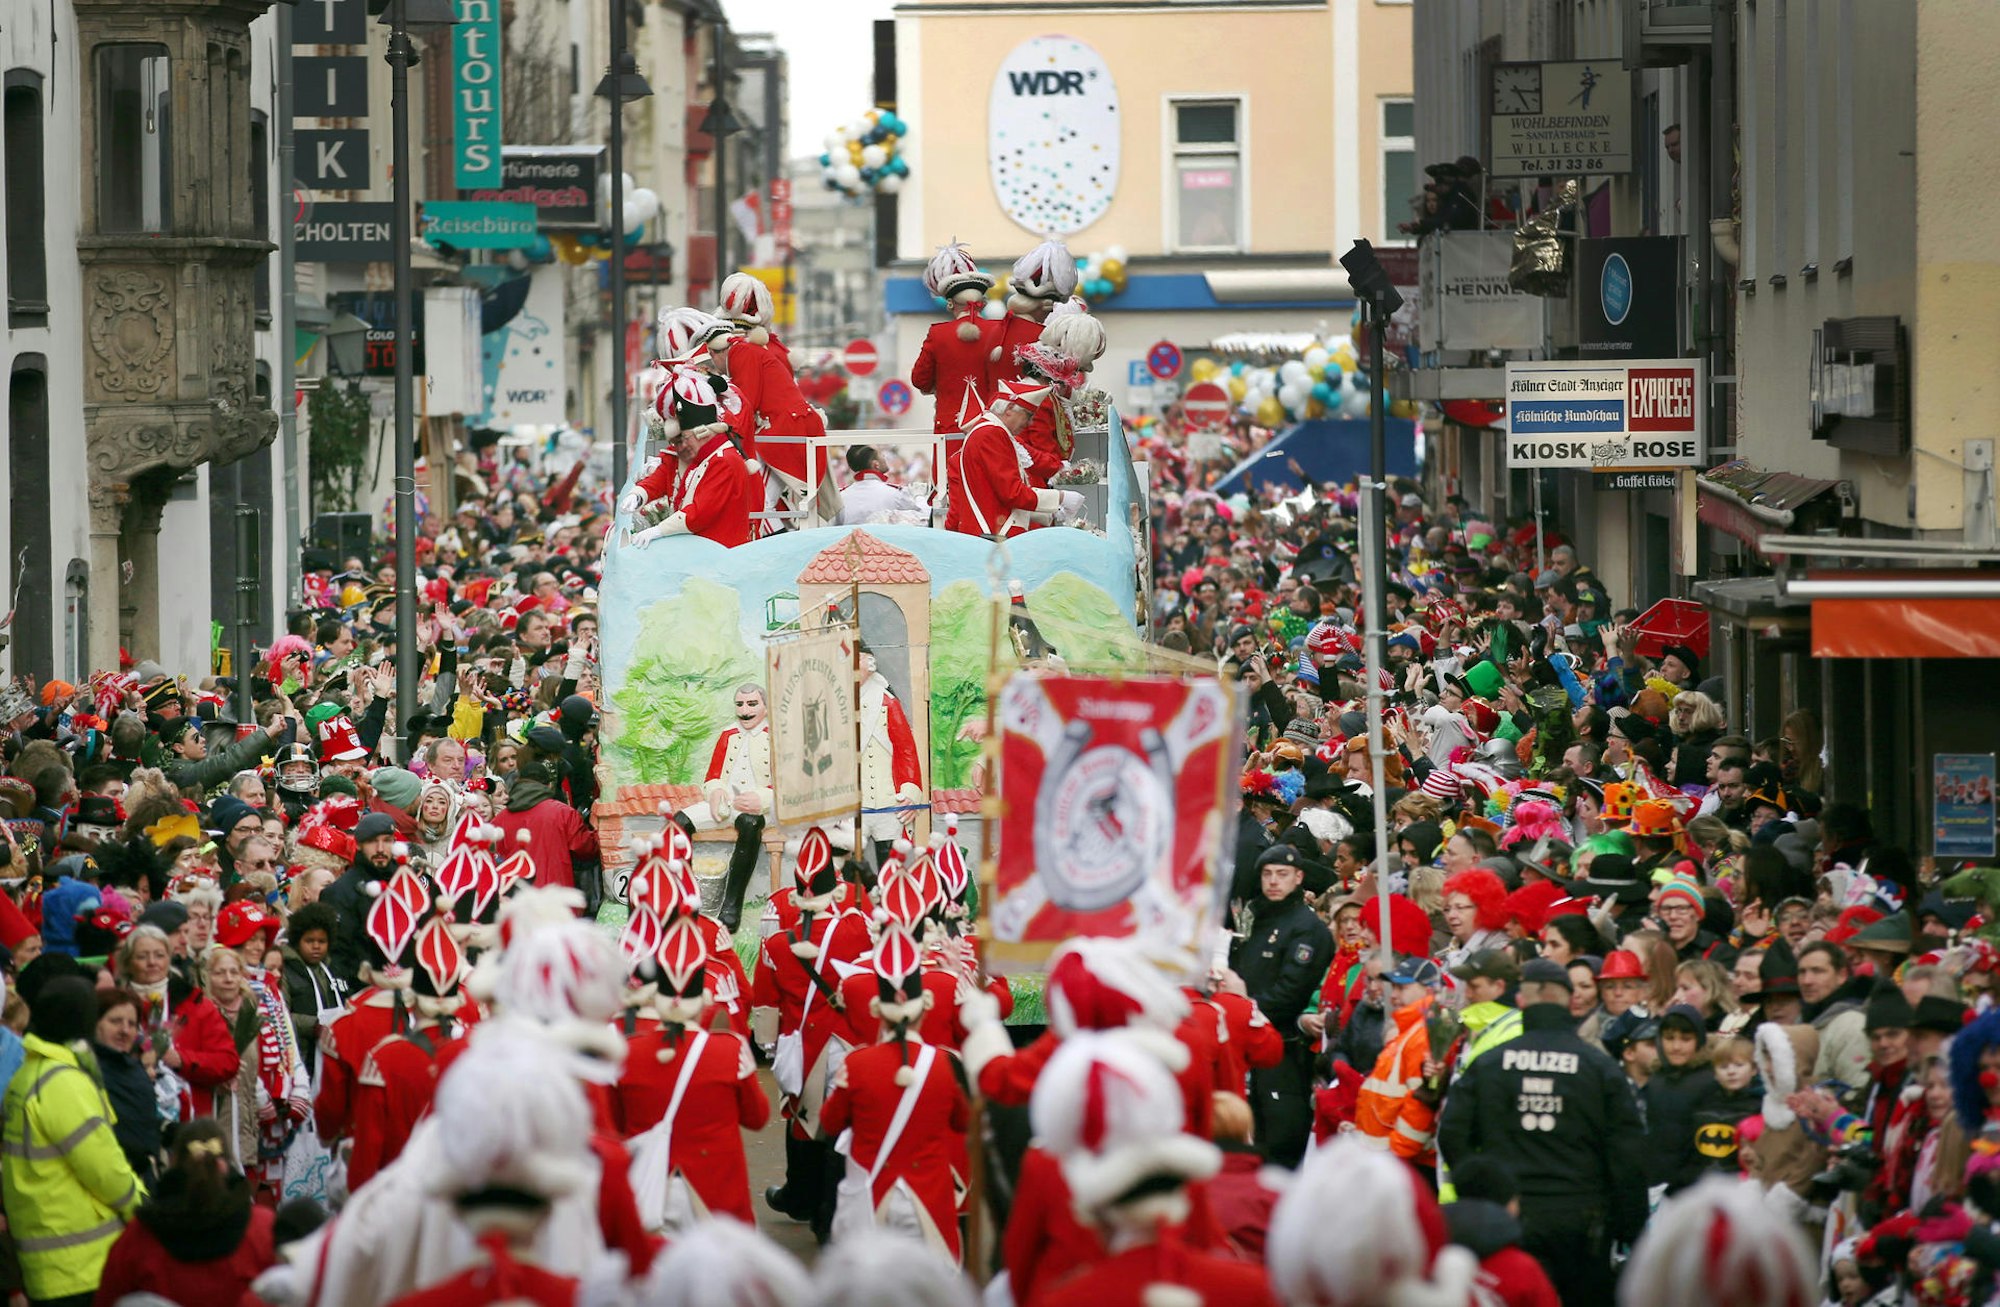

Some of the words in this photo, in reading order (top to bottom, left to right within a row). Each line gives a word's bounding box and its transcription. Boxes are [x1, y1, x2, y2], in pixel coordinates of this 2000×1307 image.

[1008, 70, 1085, 96] WDR
[1511, 115, 1610, 130] WOHLBEFINDEN
[1526, 130, 1596, 140] SANITÄTSHAUS
[1511, 141, 1612, 155] WILLECKE
[1521, 160, 1543, 171] Tel.
[1547, 159, 1561, 170] 31
[1566, 159, 1582, 170] 33
[1586, 158, 1603, 169] 86
[428, 216, 534, 234] Reisebüro
[1510, 379, 1546, 393] Kölner
[1548, 378, 1624, 392] Stadt-Anzeiger
[507, 389, 546, 403] WDR
[1631, 377, 1692, 419] EXPRESS
[1513, 442, 1587, 460] KIOSK
[1633, 441, 1695, 458] ROSE
[1616, 474, 1647, 488] Gaffel
[1502, 1049, 1580, 1075] POLIZEI
